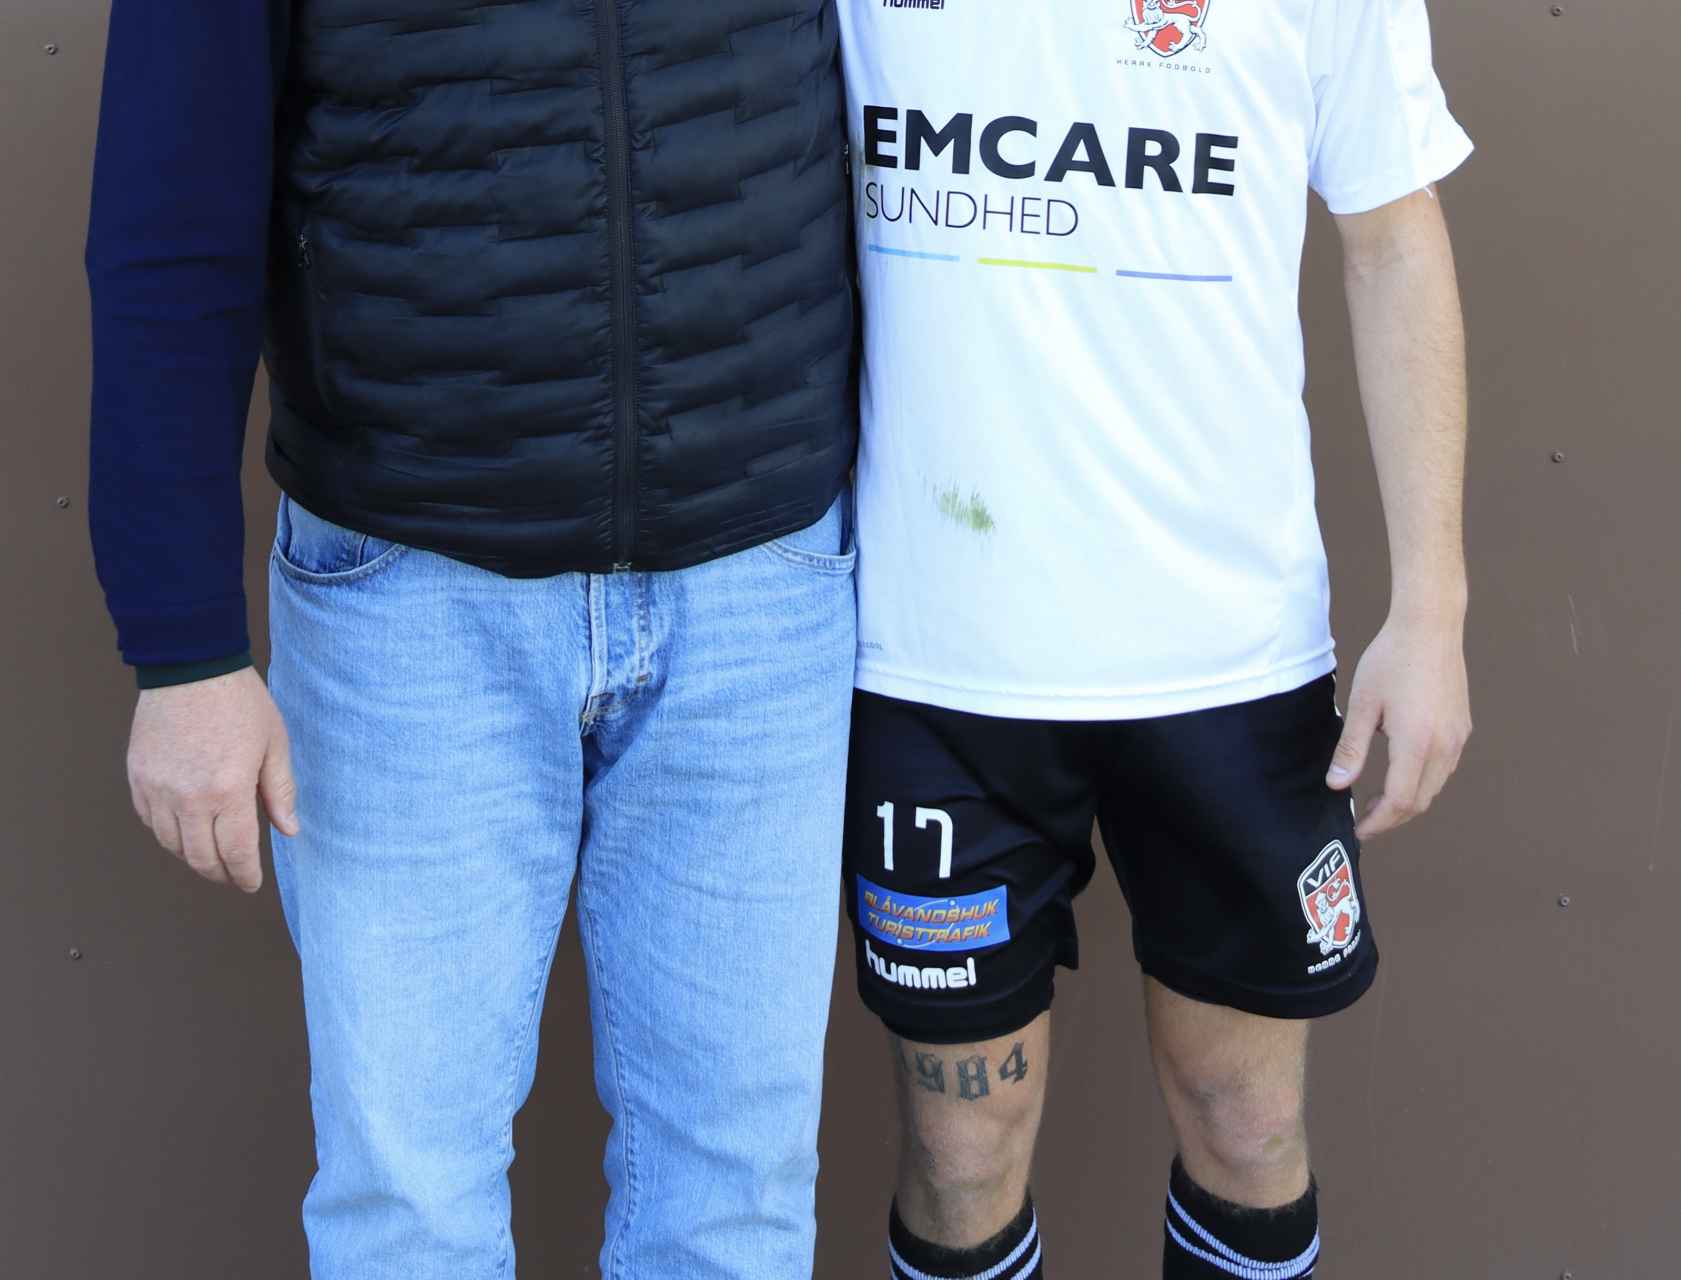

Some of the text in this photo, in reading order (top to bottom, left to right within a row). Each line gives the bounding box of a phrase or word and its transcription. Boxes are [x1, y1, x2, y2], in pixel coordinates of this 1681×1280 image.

[863, 104, 1239, 197] EMCARE
[865, 181, 1079, 237] SUNDHED
[876, 800, 954, 880] 17
[1306, 849, 1343, 889] VIF
[865, 938, 977, 989] hummel
